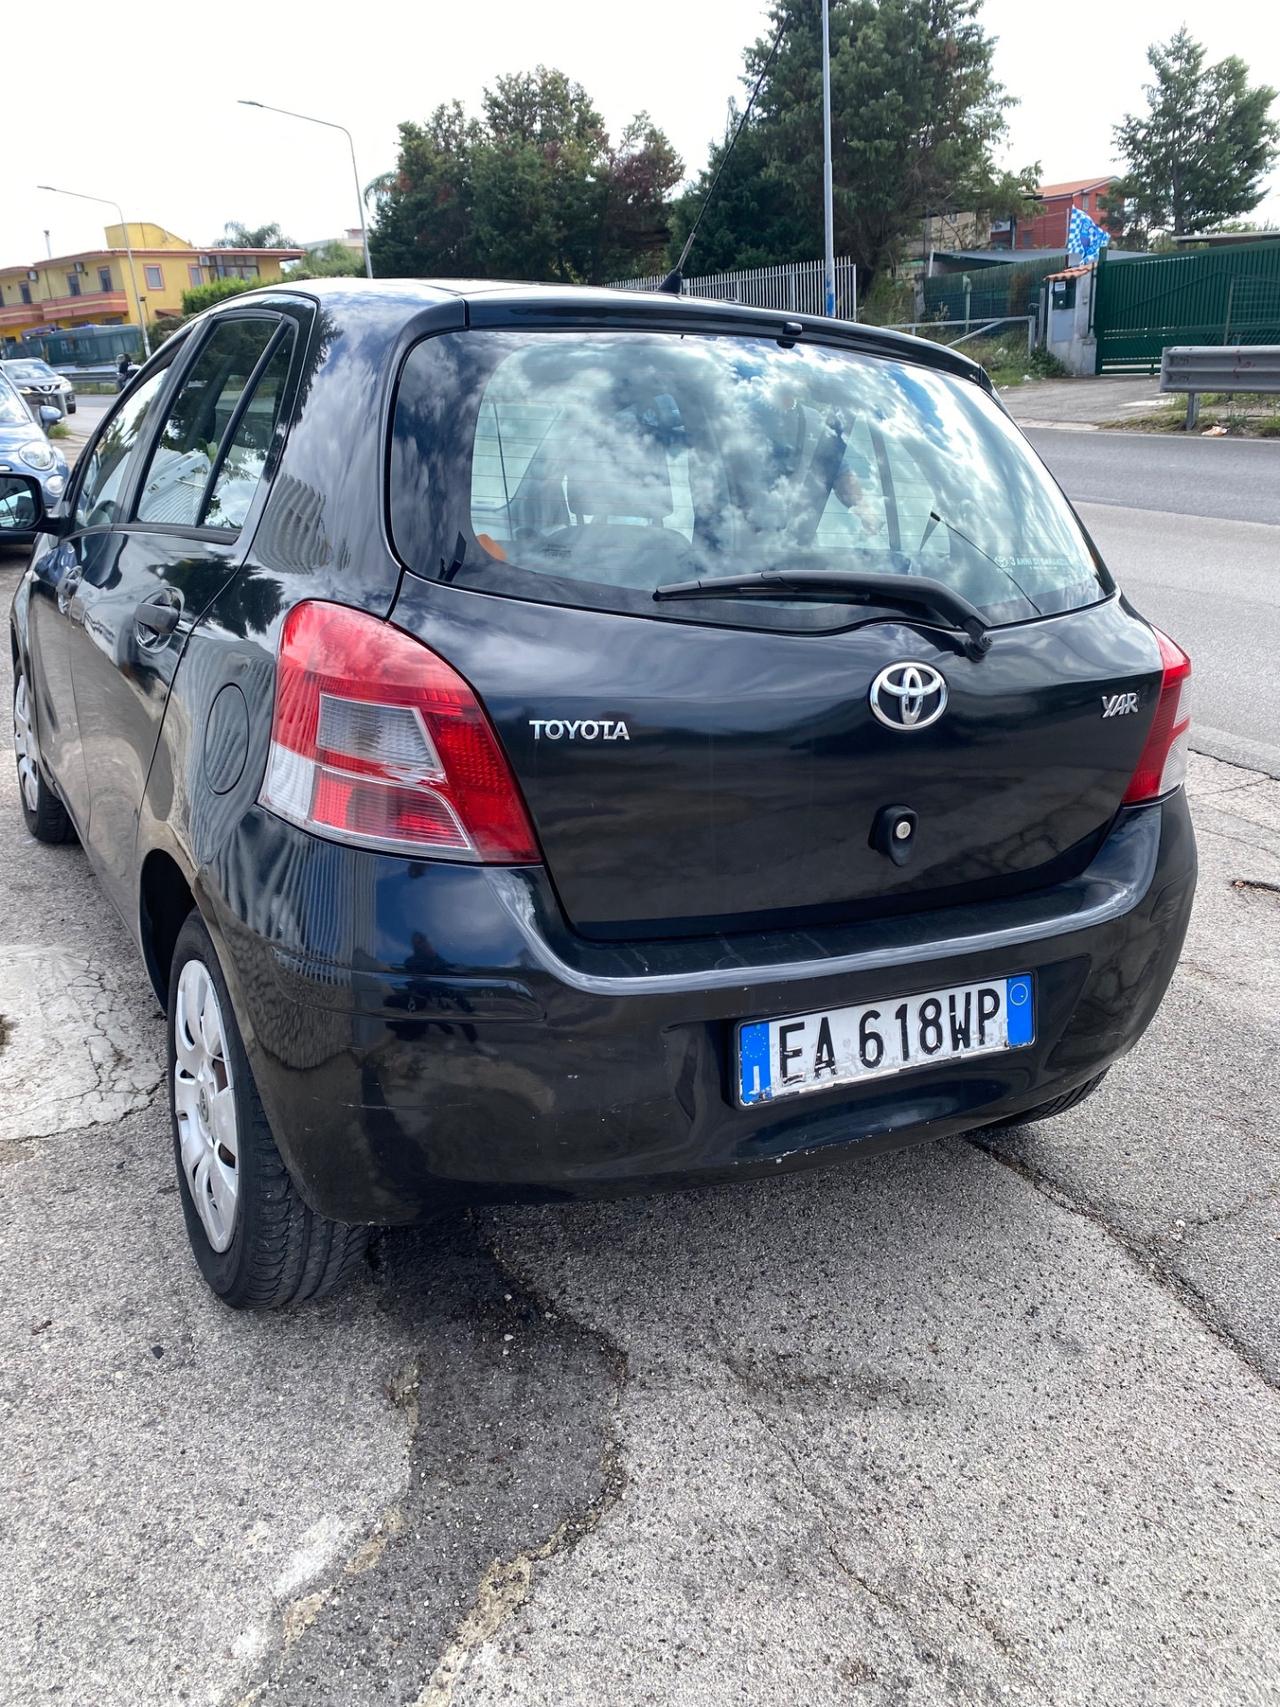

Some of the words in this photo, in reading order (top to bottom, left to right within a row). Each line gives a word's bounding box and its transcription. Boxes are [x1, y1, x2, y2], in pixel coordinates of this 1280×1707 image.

[1102, 693, 1138, 718] YAR
[529, 720, 630, 740] TOYOTA
[859, 988, 1000, 1069] 618WP
[753, 1066, 761, 1094] I
